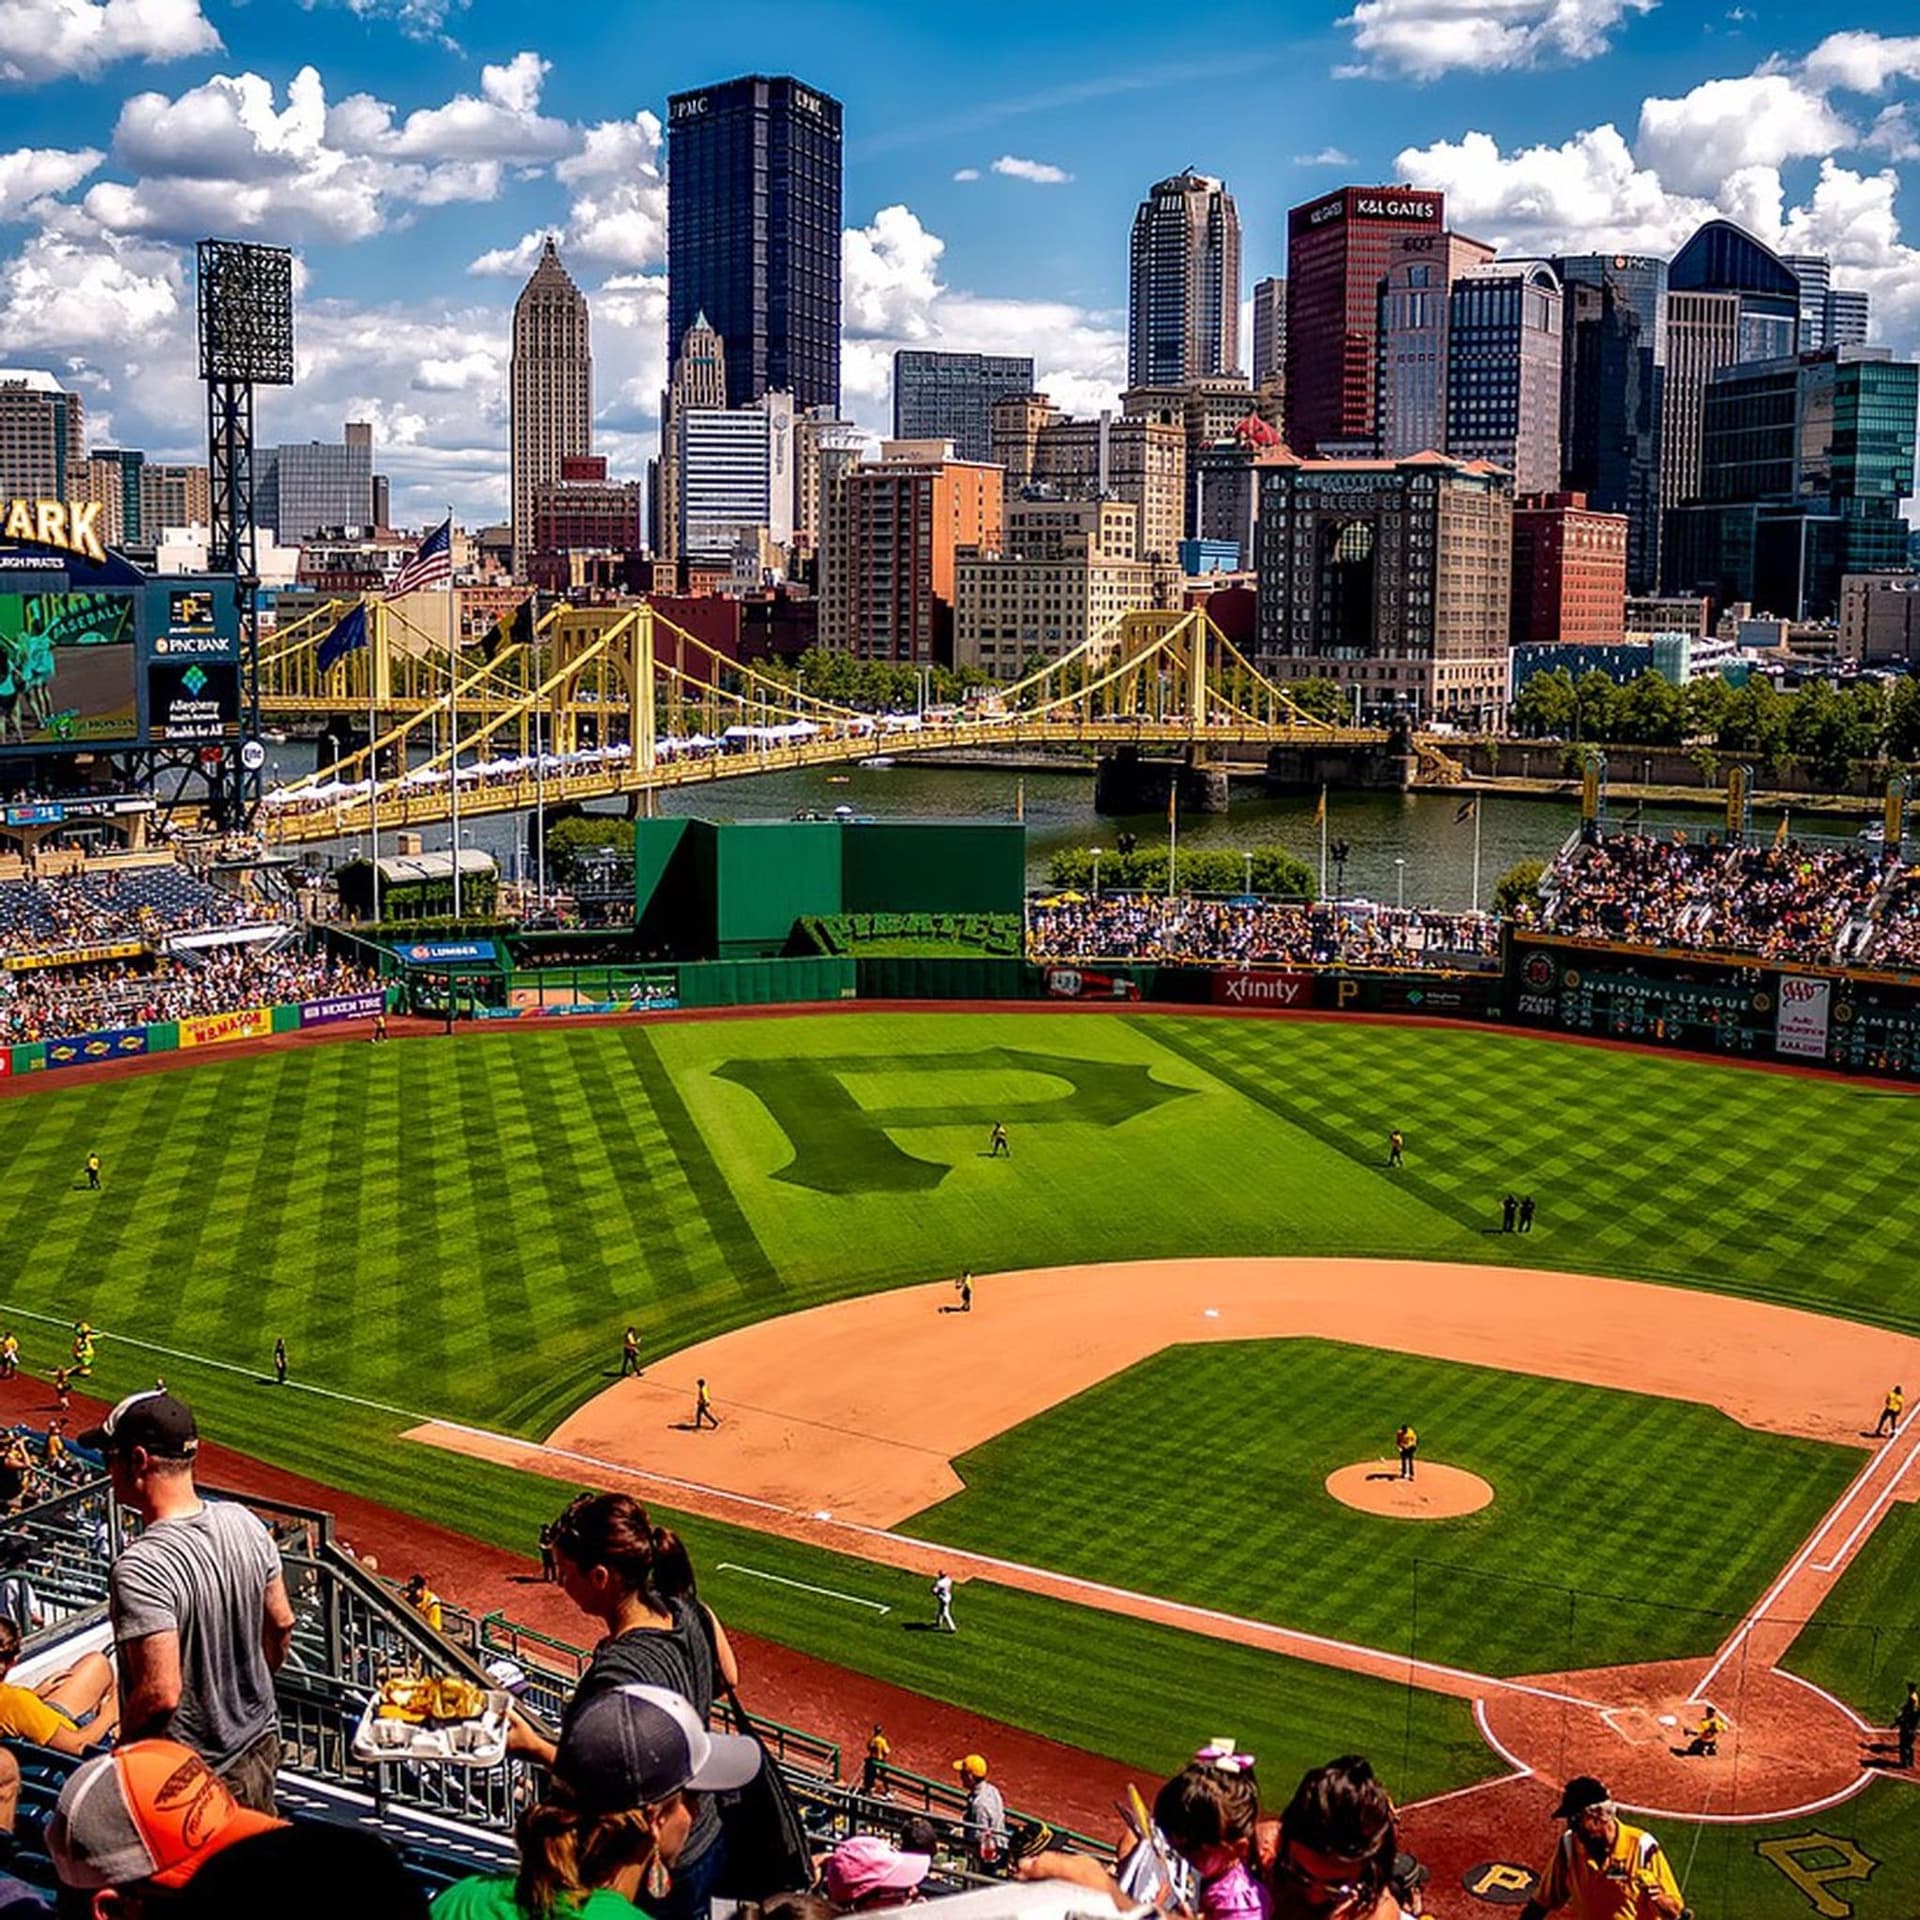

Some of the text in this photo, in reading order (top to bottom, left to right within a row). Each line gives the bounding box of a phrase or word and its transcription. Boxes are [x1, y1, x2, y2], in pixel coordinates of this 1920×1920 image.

[1357, 200, 1434, 218] K&L GATES
[0, 499, 107, 563] ARK
[1226, 976, 1300, 1004] xfinity
[1583, 980, 1750, 1012] NATIONAL LEAGUE
[1472, 1864, 1533, 1895] P
